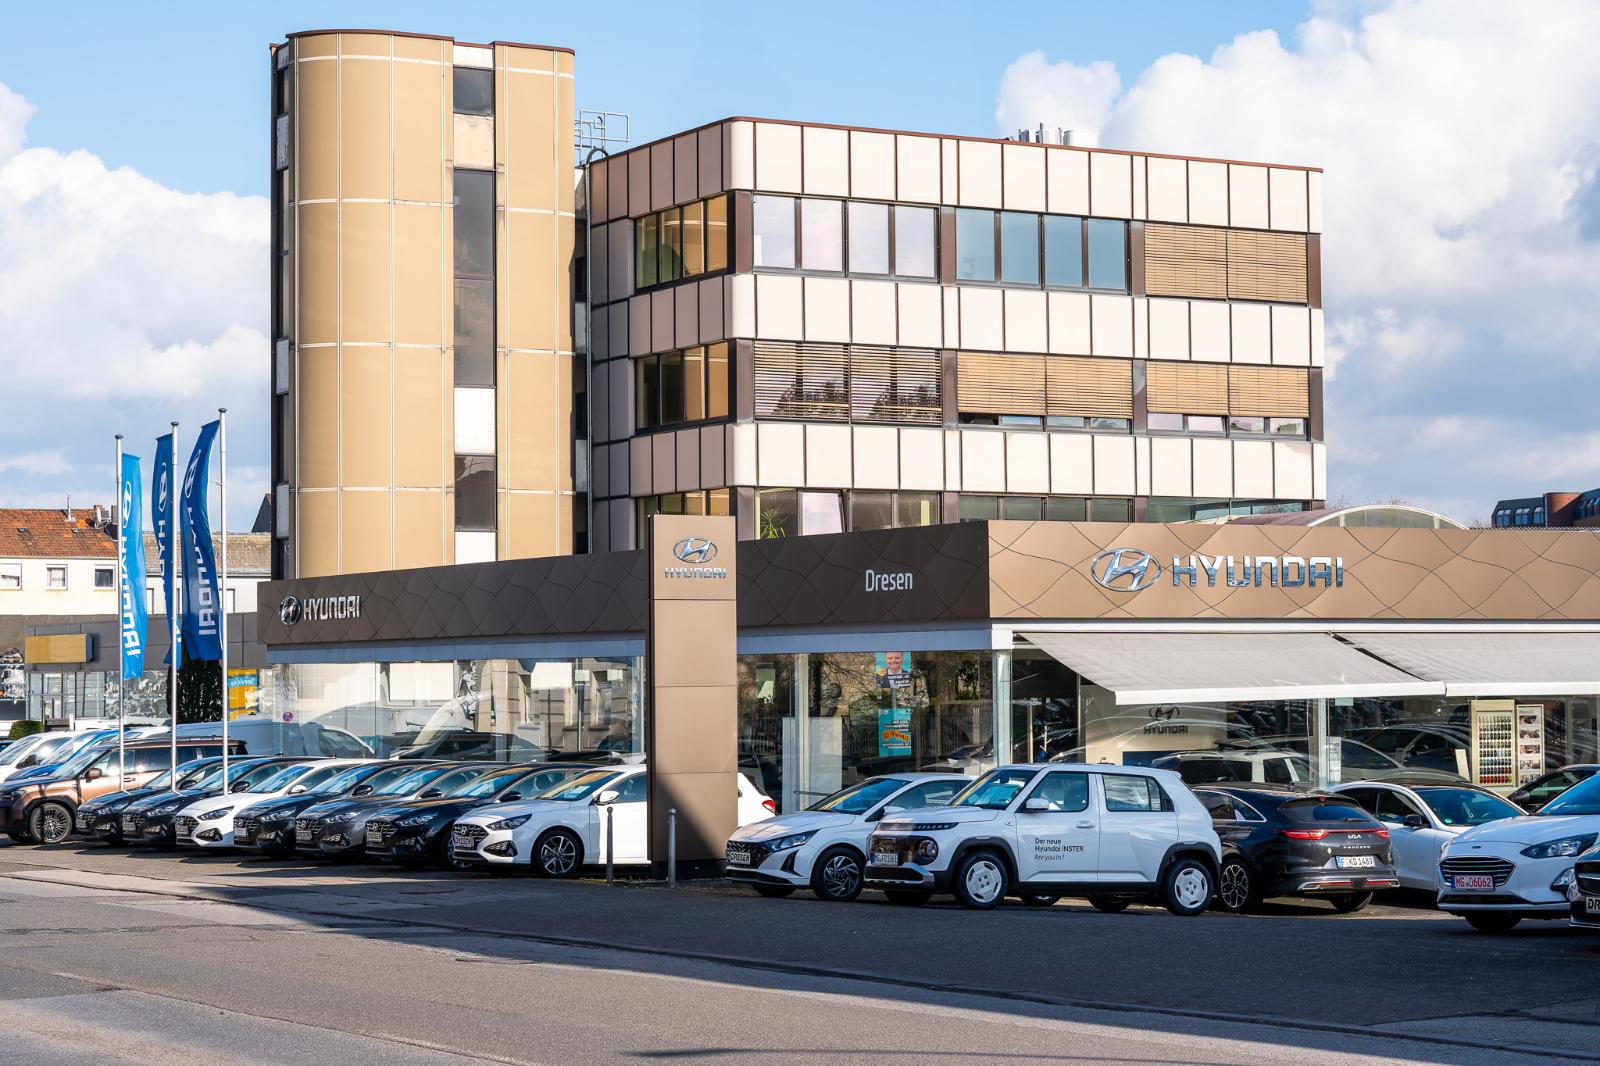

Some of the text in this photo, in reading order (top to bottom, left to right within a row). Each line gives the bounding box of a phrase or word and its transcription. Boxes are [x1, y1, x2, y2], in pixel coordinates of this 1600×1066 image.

[664, 567, 727, 579] HYUNDAI
[1172, 555, 1344, 588] HYUNDAI
[865, 569, 913, 592] Dresen
[303, 595, 360, 621] HYUNDAI
[1143, 724, 1189, 735] HYUNDAI
[1034, 837, 1046, 845] Der
[1034, 845, 1084, 853] Hyundai INSTER
